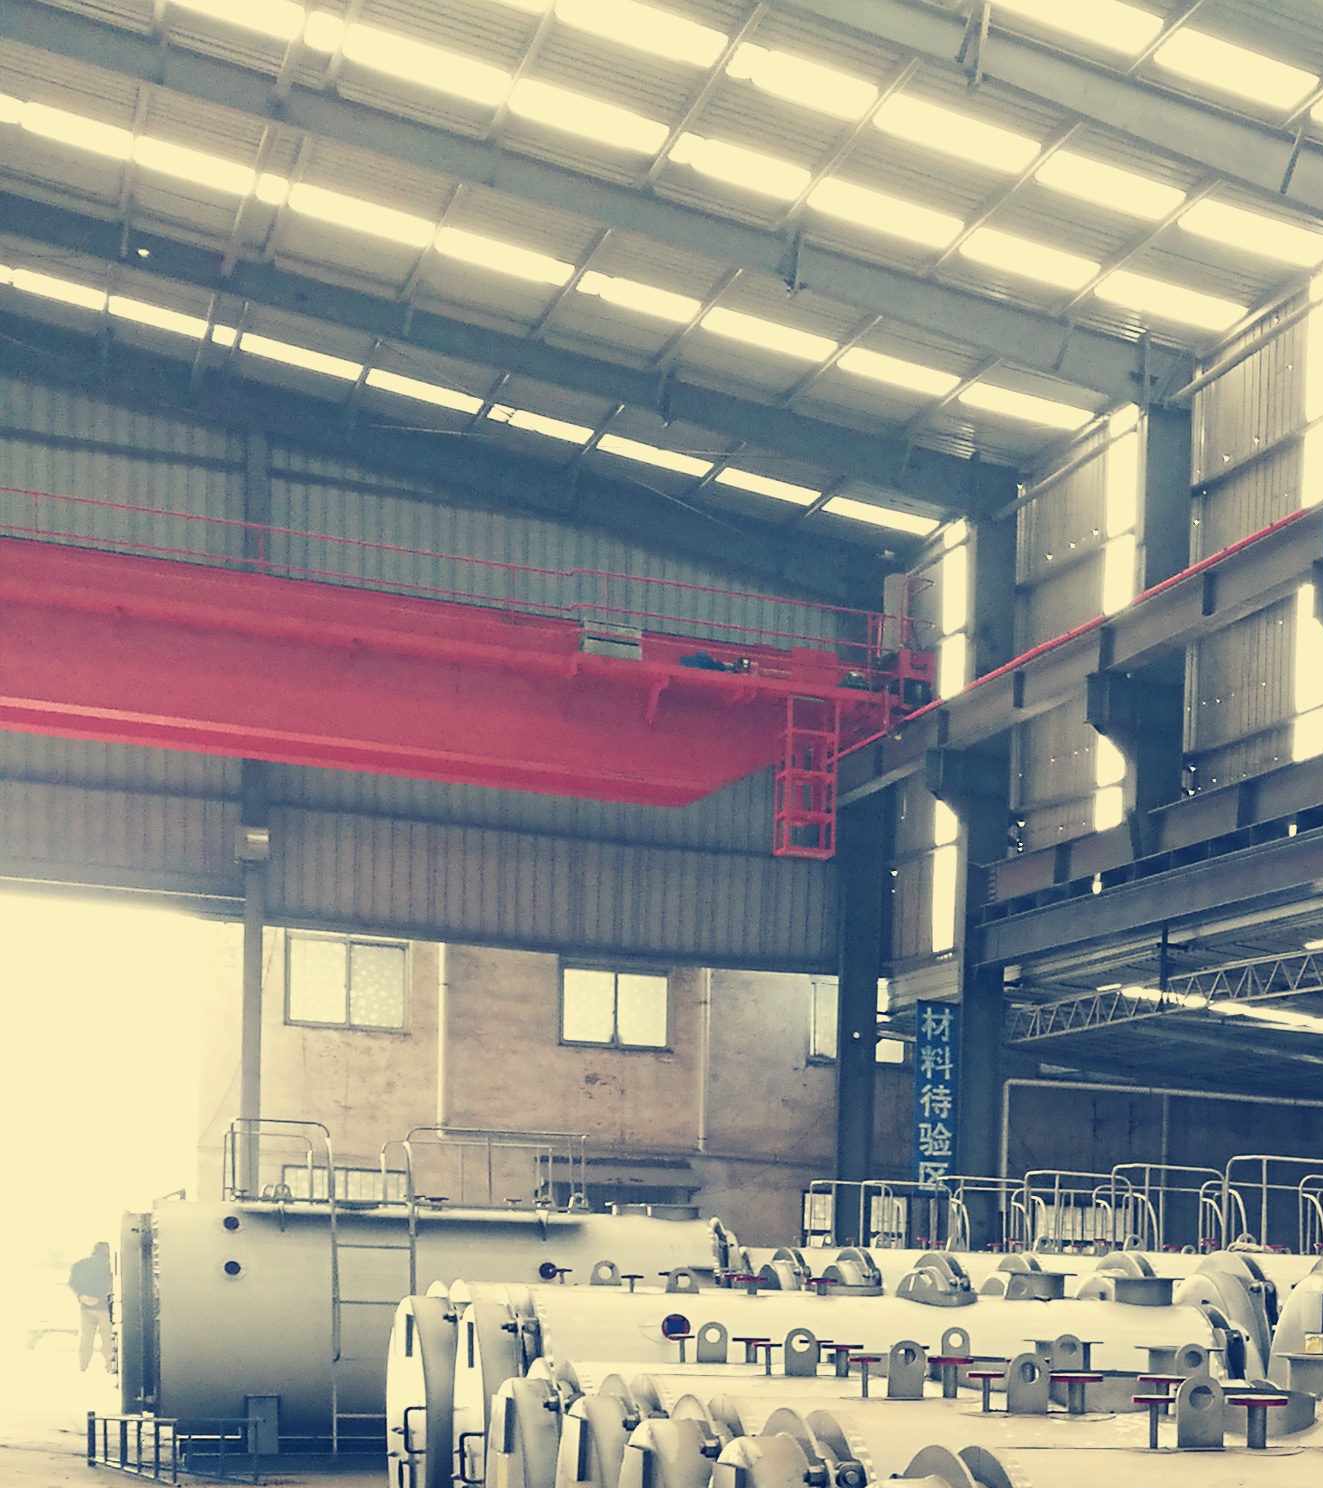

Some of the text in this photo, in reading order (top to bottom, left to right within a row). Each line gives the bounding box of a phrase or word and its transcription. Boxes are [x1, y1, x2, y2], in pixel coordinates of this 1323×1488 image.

[918, 1007, 954, 1191] 材料待验区
